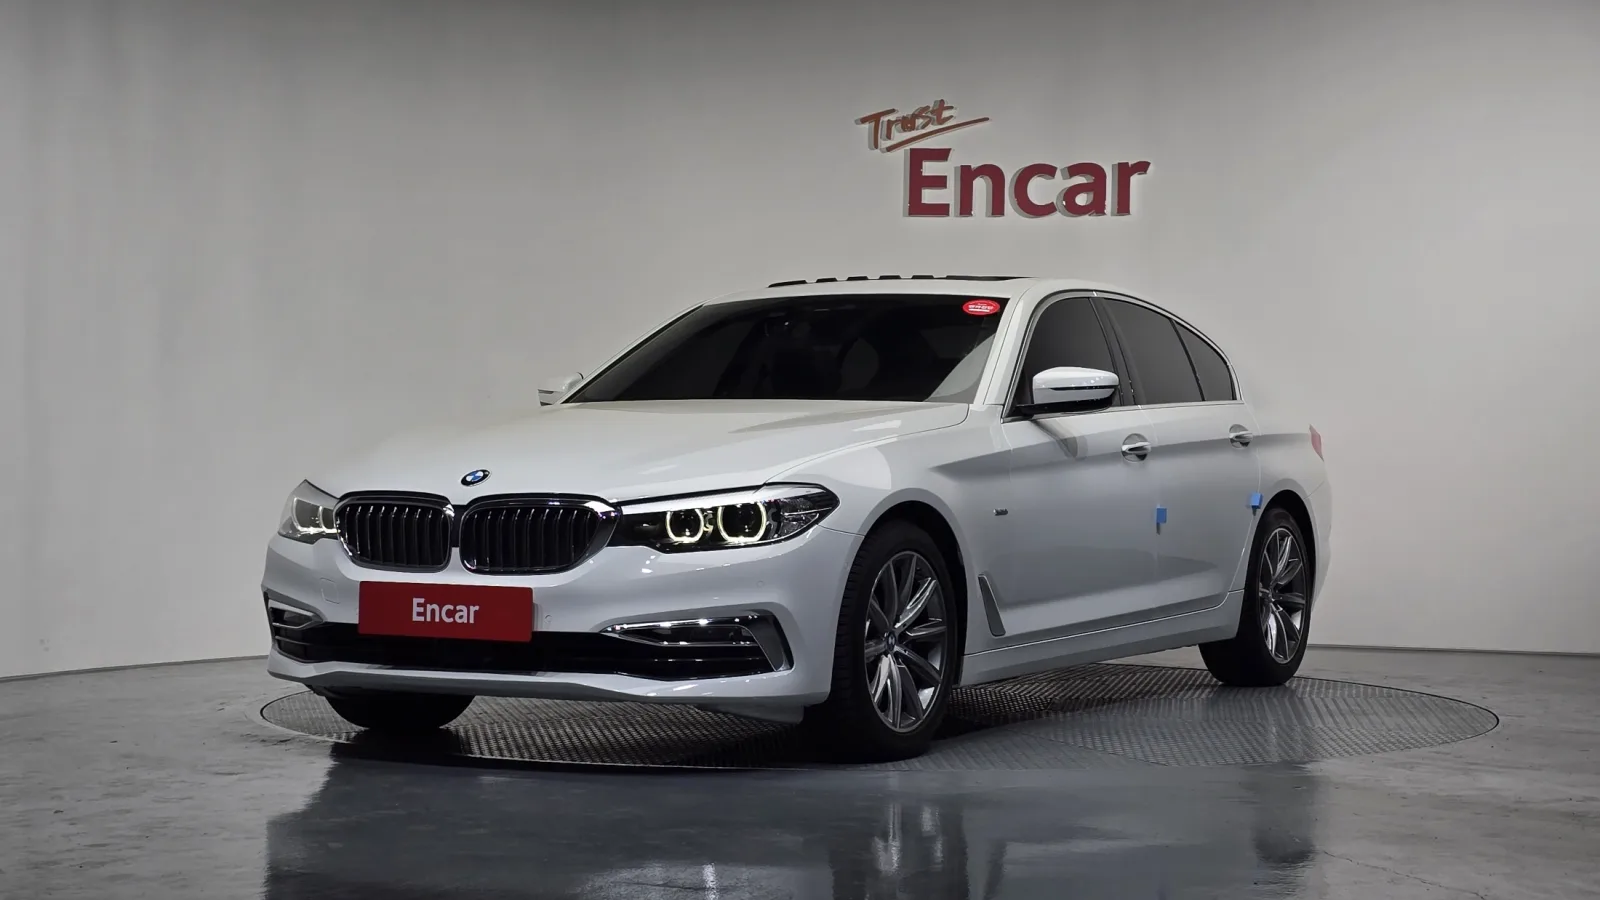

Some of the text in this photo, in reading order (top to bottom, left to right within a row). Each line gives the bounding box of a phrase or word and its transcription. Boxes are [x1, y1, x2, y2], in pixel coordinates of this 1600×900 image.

[857, 99, 955, 150] Trust
[905, 147, 1150, 217] Encar
[411, 597, 480, 624] Encar
